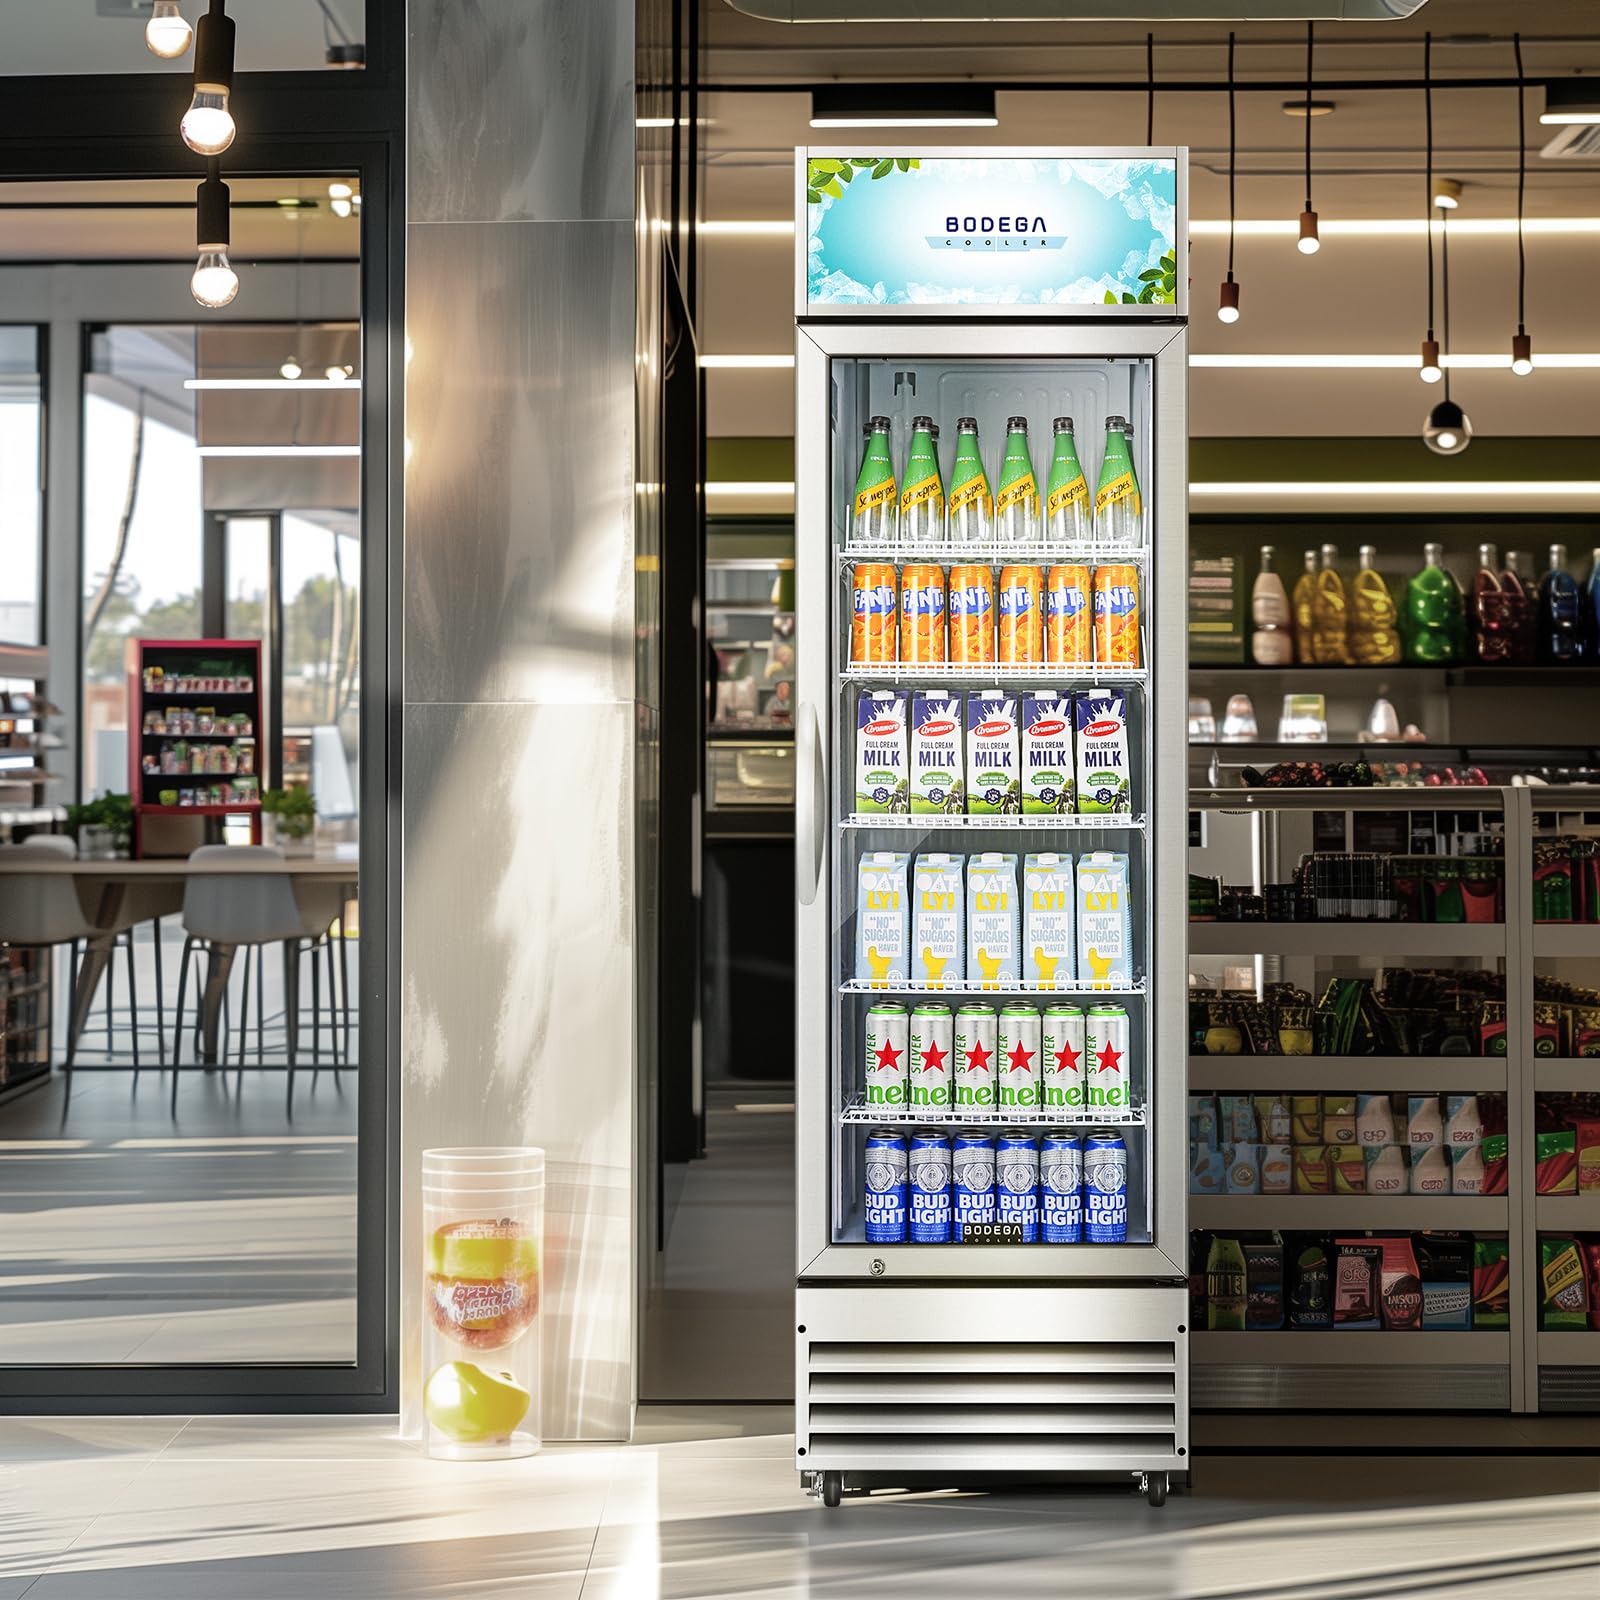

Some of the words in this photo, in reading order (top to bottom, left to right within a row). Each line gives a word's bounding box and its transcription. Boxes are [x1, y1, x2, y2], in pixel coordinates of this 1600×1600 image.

[945, 216, 1047, 233] BODEGA
[945, 239, 1047, 247] COOLER
[854, 587, 895, 609] FANTA
[950, 587, 991, 610] FANTA
[864, 750, 900, 766] MILK
[919, 751, 955, 767] MILK
[975, 751, 1012, 767] MILK
[1030, 751, 1066, 767] MILK
[1085, 751, 1121, 767] MILK
[867, 891, 898, 910] LY!
[922, 892, 954, 911] LY!
[975, 892, 1008, 911] LY!
[1032, 891, 1064, 911] LY!
[1086, 892, 1118, 911] LY!
[864, 929, 900, 941] SUGARS
[920, 930, 955, 942] SUGARS
[974, 930, 1009, 943] SUGARS
[1031, 930, 1066, 942] SUGARS
[1084, 930, 1120, 942] SUGARS
[878, 943, 898, 952] HAVER
[933, 945, 953, 953] HAVER
[988, 945, 1008, 953] HAVER
[1045, 944, 1064, 952] HAVER
[1098, 944, 1118, 953] HAVER
[867, 1033, 876, 1072] SILVER
[912, 1034, 921, 1073] SILVER
[956, 1034, 966, 1073] SILVER
[999, 1035, 1008, 1074] SILVER
[1044, 1035, 1055, 1074] SILVER
[1087, 1035, 1096, 1074] SILVER
[865, 1193, 899, 1209] BUD
[913, 1194, 950, 1209] BUD
[960, 1194, 994, 1209] BUD
[1000, 1195, 1037, 1210] BUD
[1044, 1195, 1080, 1210] BUD
[1089, 1194, 1125, 1210] BUD
[964, 1225, 1022, 1235] BODEGA
